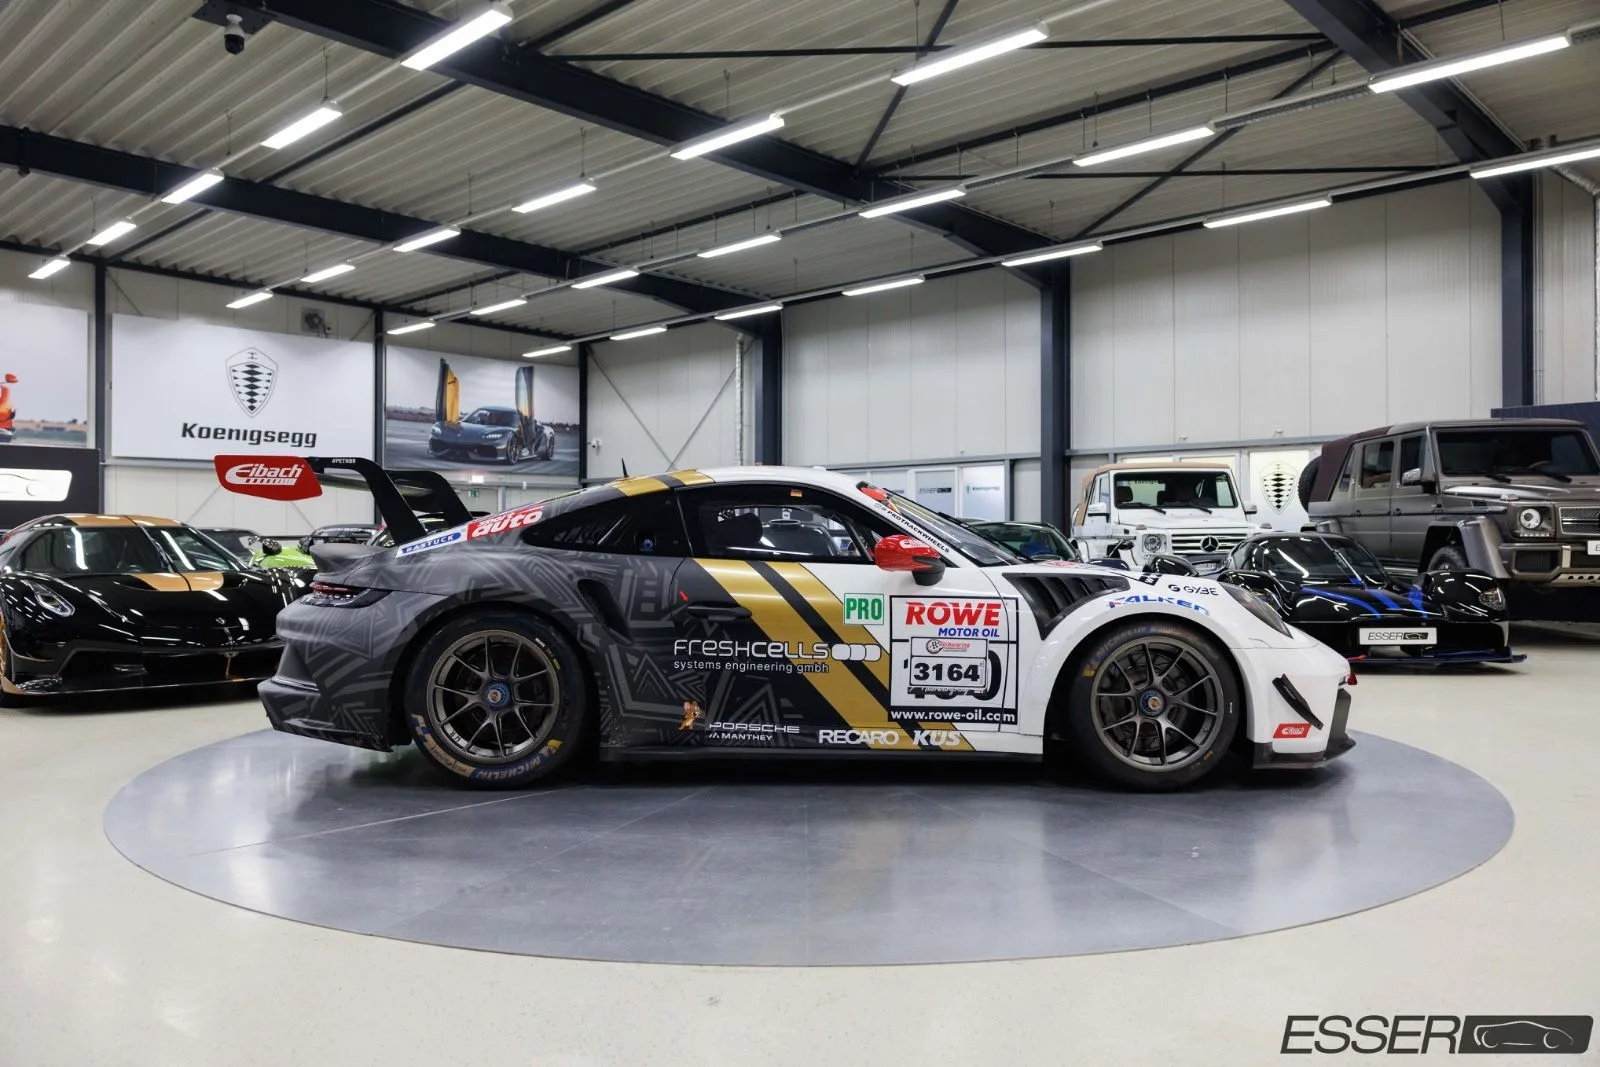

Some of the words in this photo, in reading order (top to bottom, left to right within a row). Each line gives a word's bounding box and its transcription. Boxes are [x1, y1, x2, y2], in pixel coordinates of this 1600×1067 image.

[181, 422, 317, 448] Koenigsegg
[225, 463, 302, 486] Eibach
[471, 510, 543, 538] auto
[845, 597, 883, 621] PRO
[904, 601, 1002, 627] ROWE
[1106, 595, 1210, 616] FALKEN
[938, 627, 978, 638] MOTOR
[981, 628, 1000, 638] OIL
[1368, 632, 1403, 641] ESSER
[673, 660, 721, 670] systems
[725, 661, 793, 674] engineering
[797, 662, 829, 673] gmbh
[913, 662, 980, 682] 3164
[890, 709, 1016, 723] www.rowe-oil.com
[709, 721, 800, 734] PORSCHE
[721, 732, 773, 741] MANTHEY
[818, 729, 899, 745] RECARO
[912, 730, 961, 746] KÜS
[475, 756, 542, 780] MICHELIN
